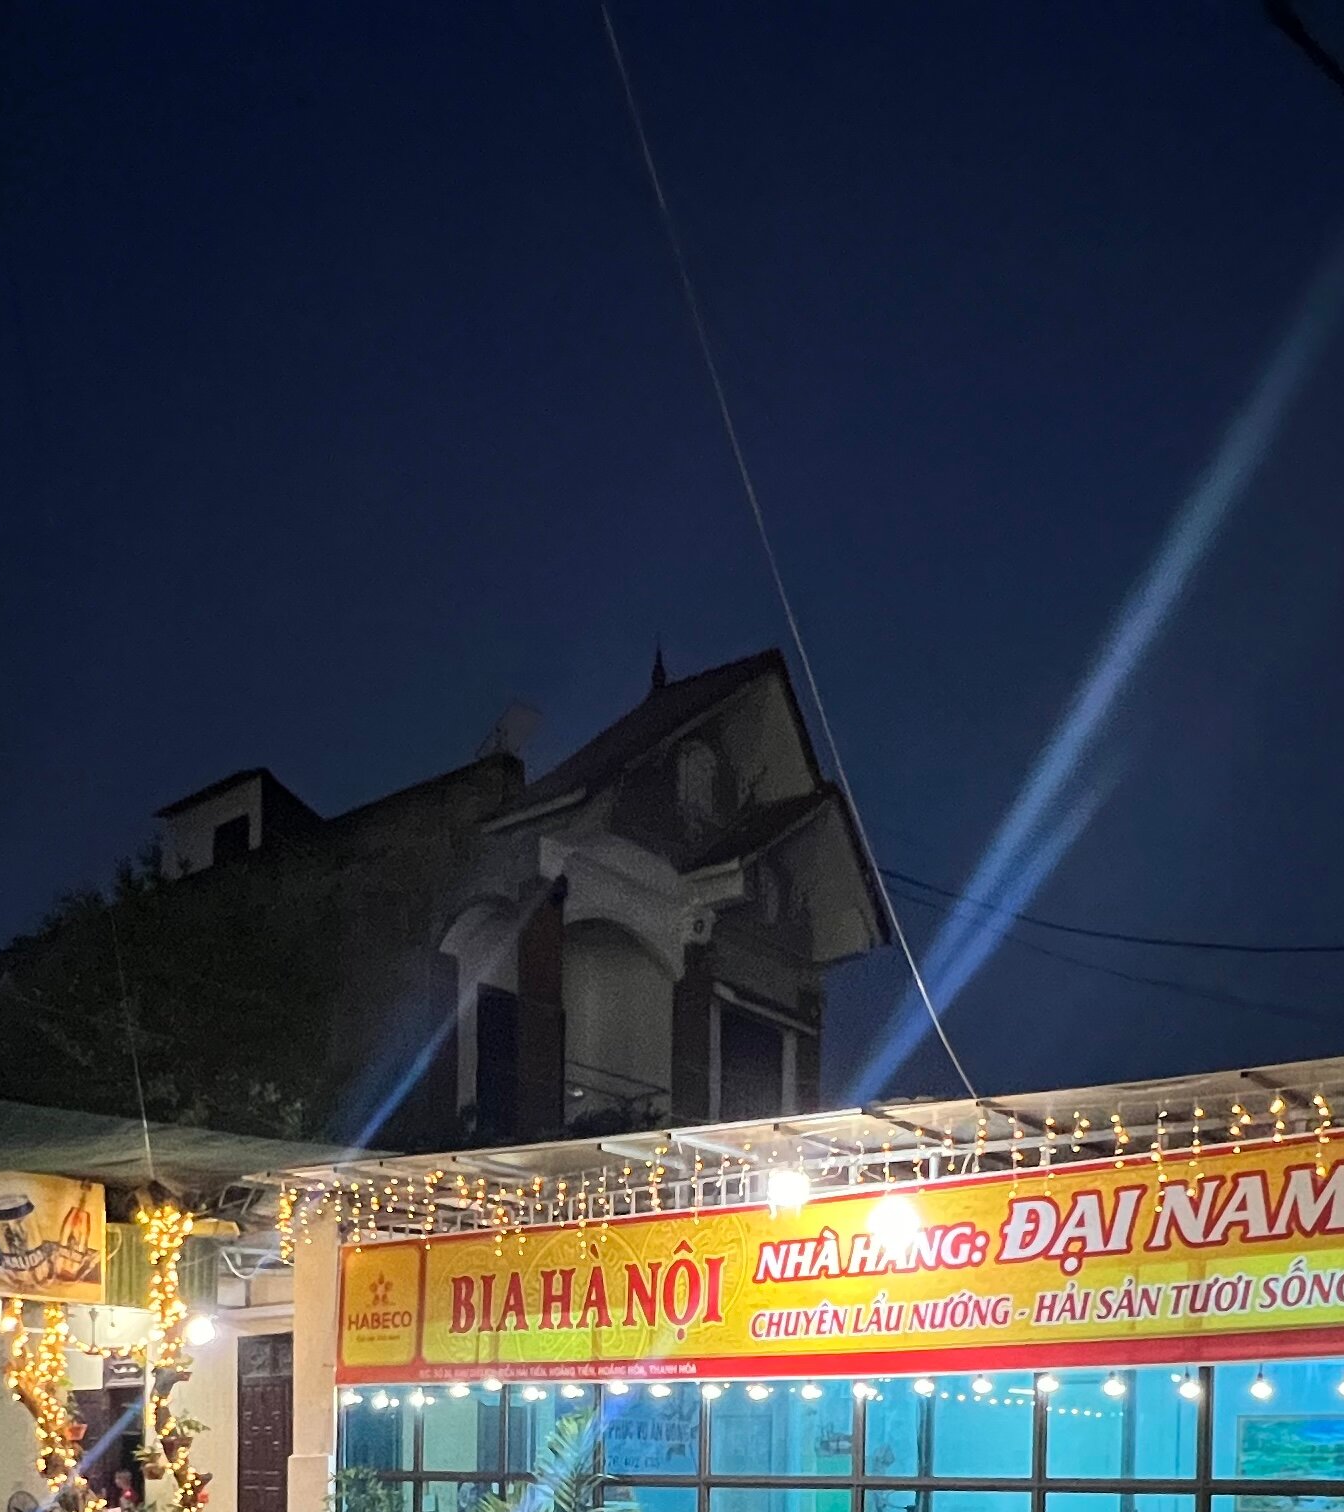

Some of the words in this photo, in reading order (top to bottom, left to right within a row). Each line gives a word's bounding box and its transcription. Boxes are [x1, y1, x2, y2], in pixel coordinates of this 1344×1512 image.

[752, 1225, 841, 1283] NHÀ
[994, 1183, 1148, 1277] ĐẠI
[347, 1310, 413, 1331] HABECO
[447, 1270, 530, 1334] BIA
[537, 1242, 614, 1331] HÀ
[621, 1238, 726, 1341] NỘI
[750, 1301, 849, 1338] CHUYÊN
[852, 1291, 905, 1335] LẨU
[908, 1293, 1011, 1331] NƯỚNG
[1034, 1281, 1090, 1325] HẢI
[1096, 1276, 1162, 1322] SẢN
[1171, 1276, 1253, 1316] TƯƠI
